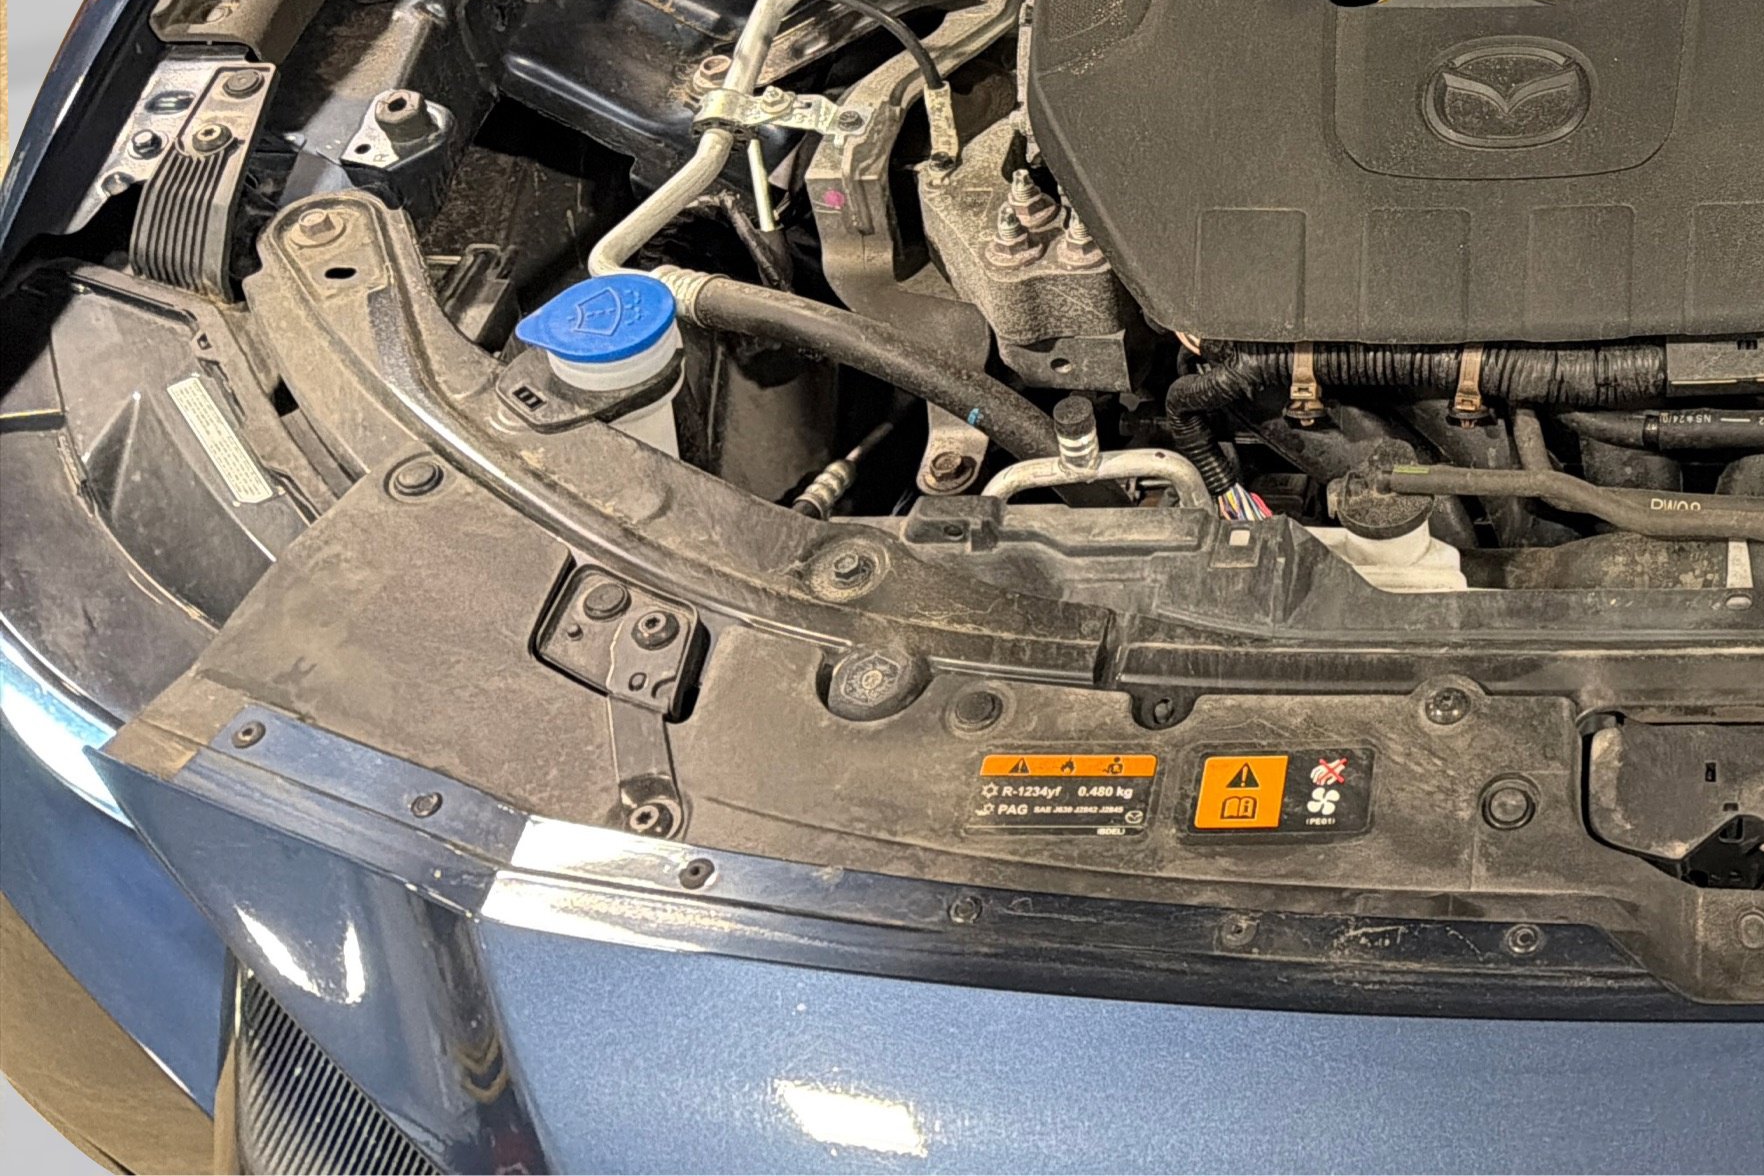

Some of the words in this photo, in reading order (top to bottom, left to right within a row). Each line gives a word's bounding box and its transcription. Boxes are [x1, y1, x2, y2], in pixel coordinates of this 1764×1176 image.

[1002, 786, 1062, 799] R-1234yf
[1077, 786, 1113, 797] 0.480
[1116, 787, 1133, 799] kg
[998, 804, 1028, 815] PAG
